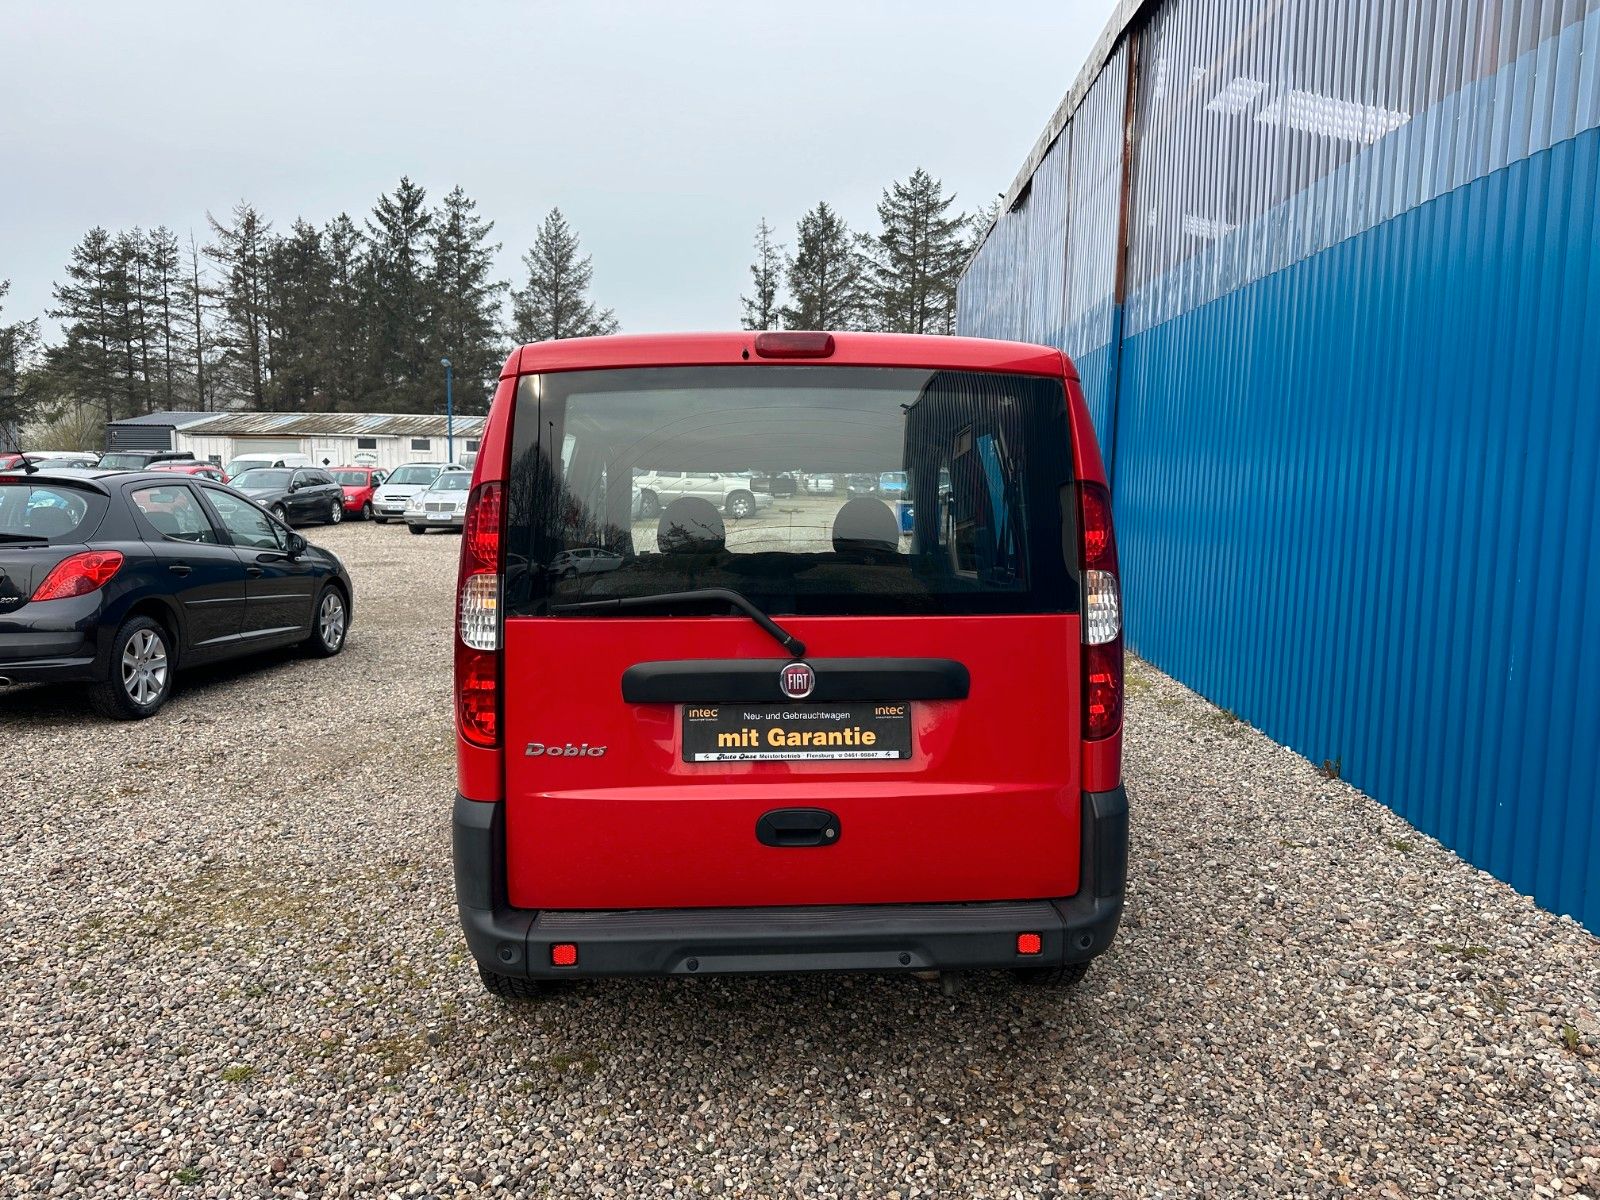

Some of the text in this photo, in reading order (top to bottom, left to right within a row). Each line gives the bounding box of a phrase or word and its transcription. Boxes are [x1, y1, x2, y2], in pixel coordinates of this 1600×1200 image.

[788, 673, 809, 690] FIAT
[688, 708, 718, 718] intec
[875, 706, 904, 715] intec
[743, 711, 851, 722] Neu- und Gebrauchtwagen
[717, 726, 877, 747] mit Garantie
[806, 752, 835, 760] Flensburg
